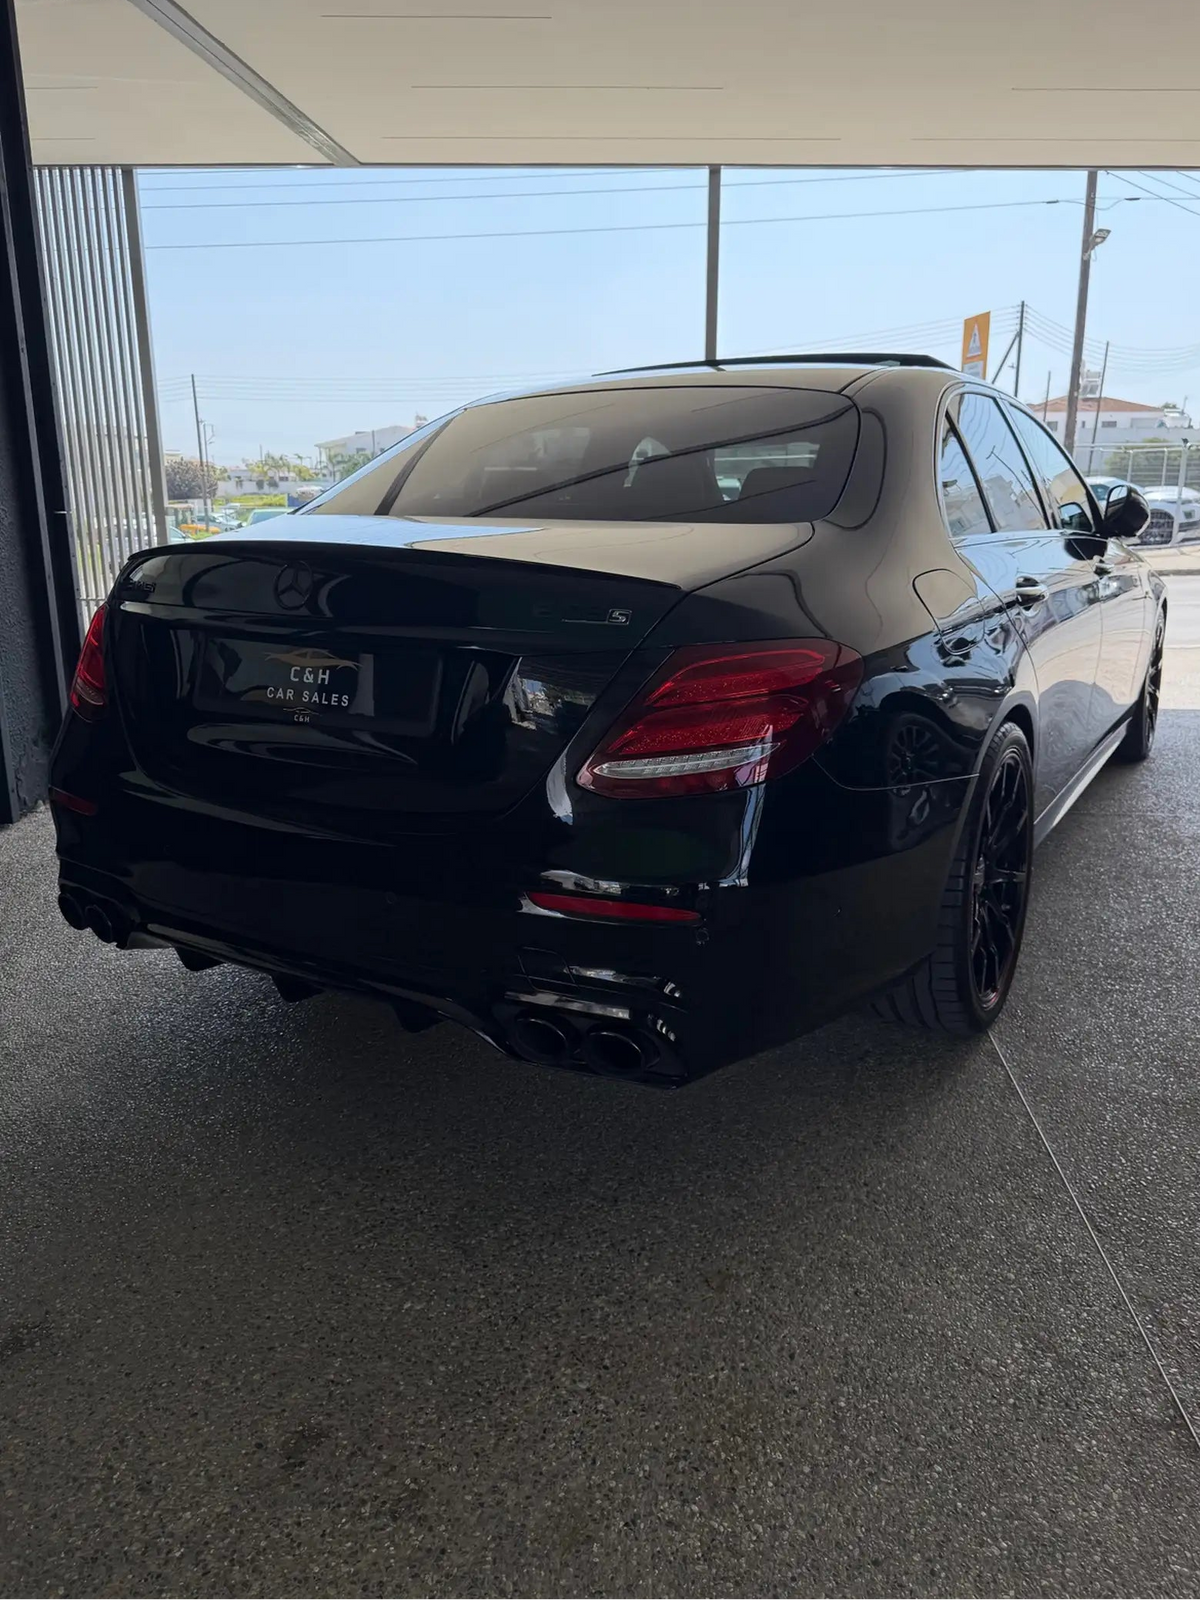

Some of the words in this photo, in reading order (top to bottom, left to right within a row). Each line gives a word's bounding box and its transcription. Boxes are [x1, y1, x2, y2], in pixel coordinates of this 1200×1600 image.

[608, 610, 630, 623] S
[290, 666, 330, 684] C&H
[267, 687, 294, 700] CAR
[302, 691, 349, 706] SALES
